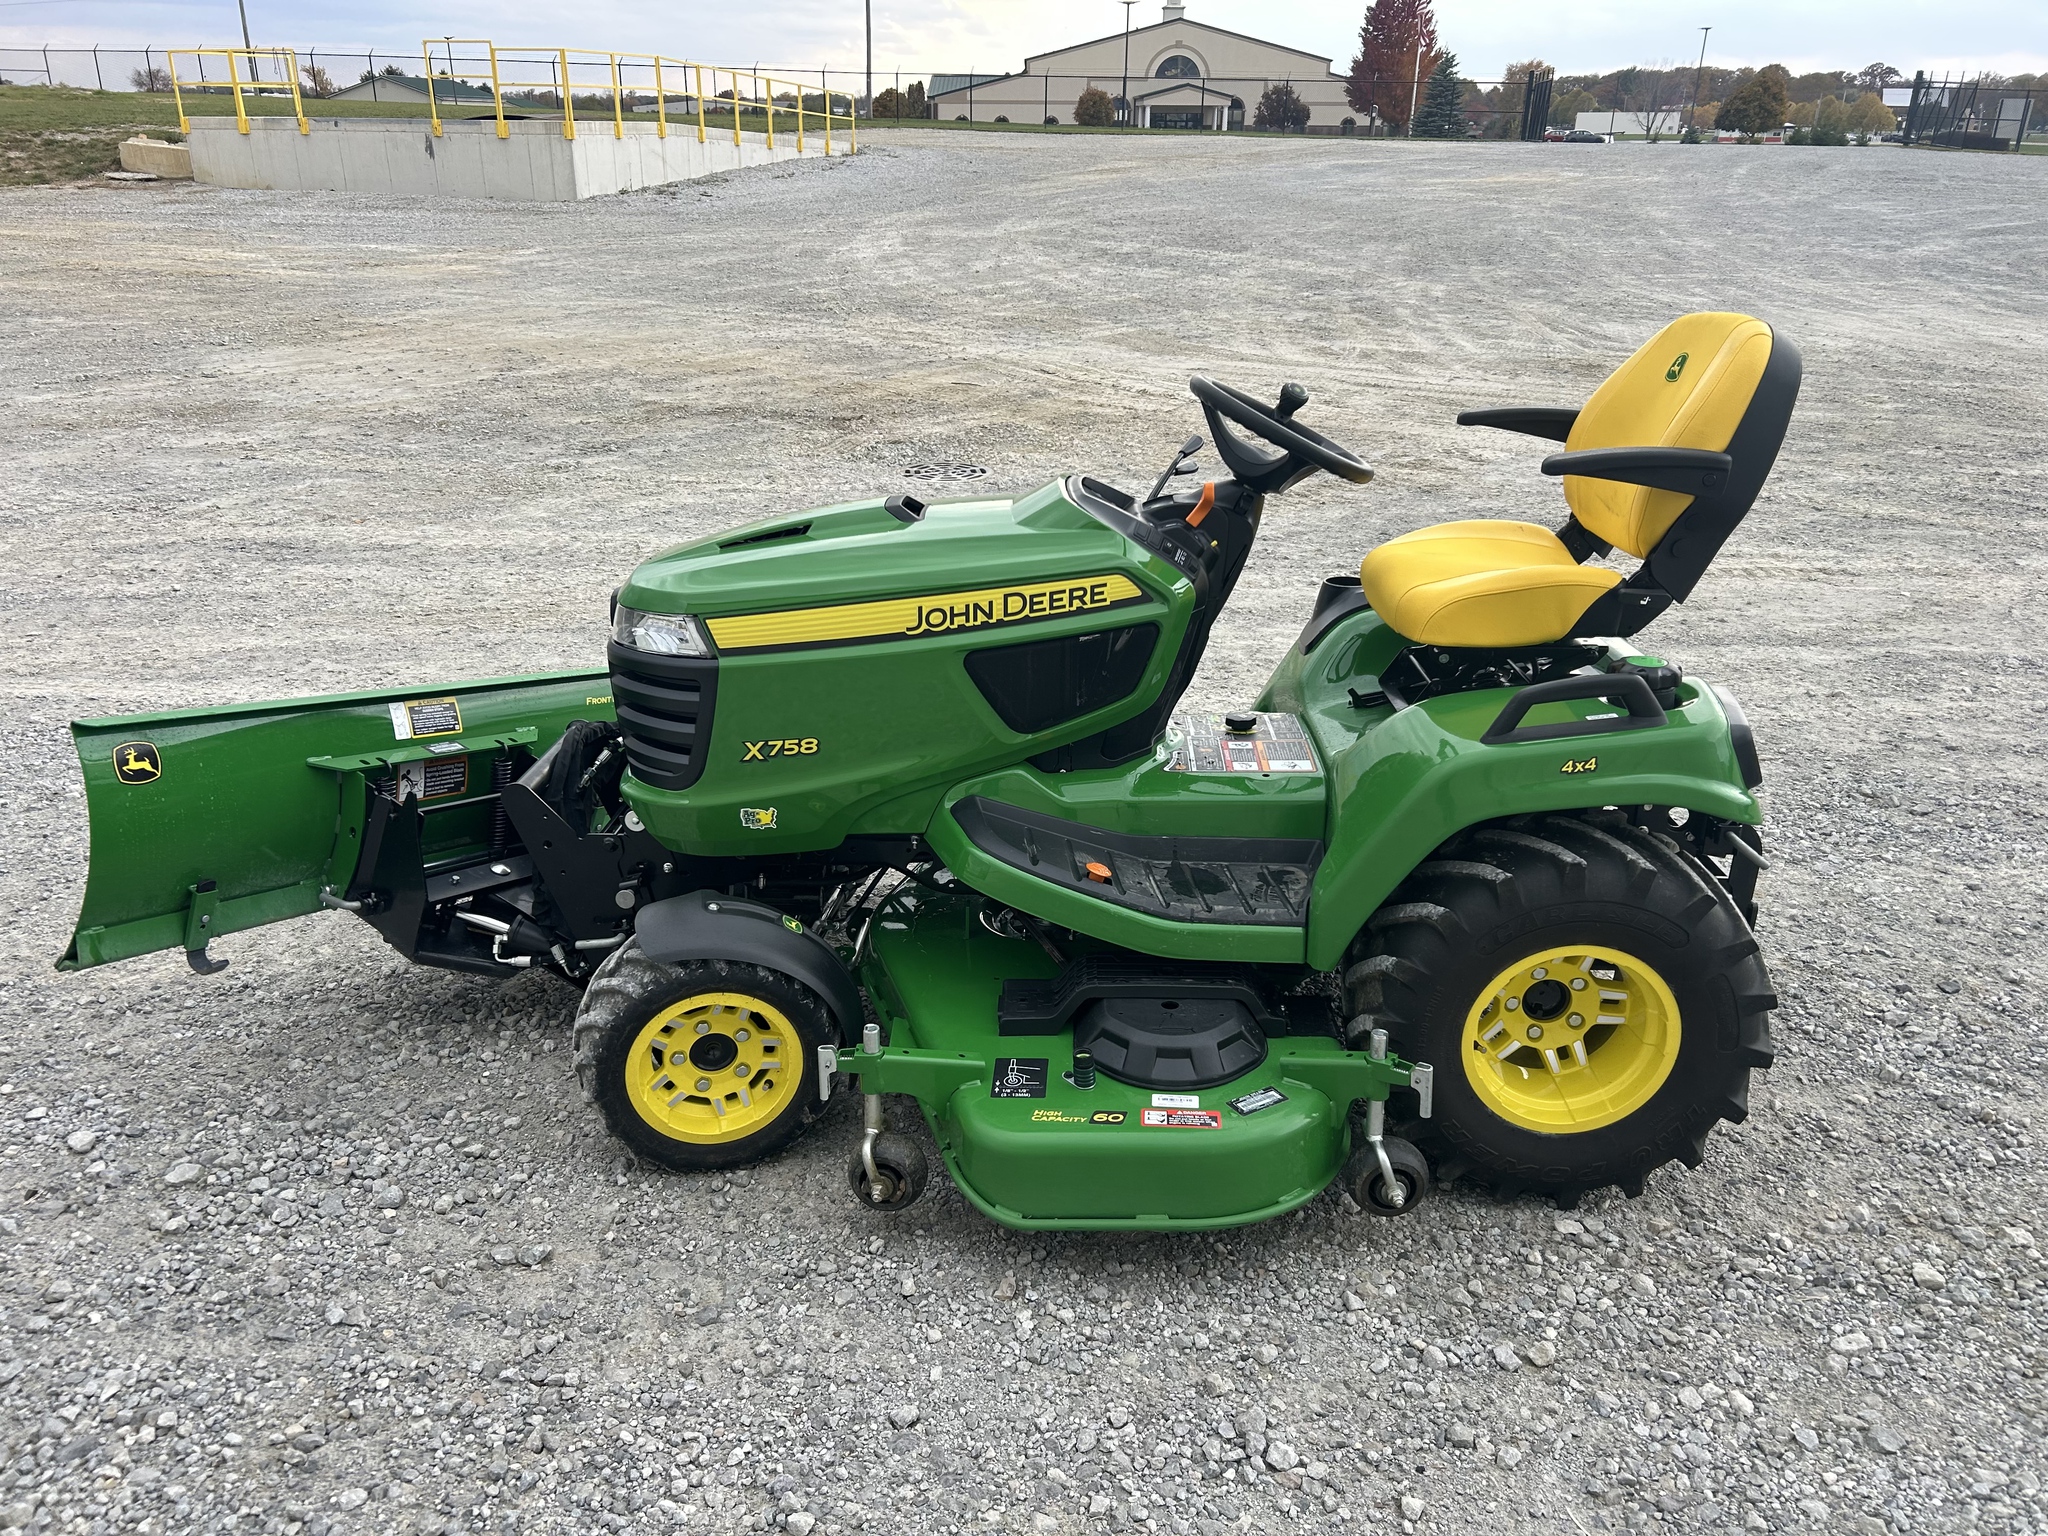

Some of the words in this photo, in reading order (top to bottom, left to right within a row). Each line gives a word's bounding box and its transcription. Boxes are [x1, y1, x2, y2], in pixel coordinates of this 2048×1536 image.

[905, 600, 995, 633] JOHN
[1002, 582, 1109, 619] DEERE
[586, 695, 612, 706] FRONT
[742, 737, 819, 761] X758
[1560, 757, 1597, 774] 4x4
[1493, 902, 1679, 943] CARLSLE
[1092, 1113, 1124, 1122] 60
